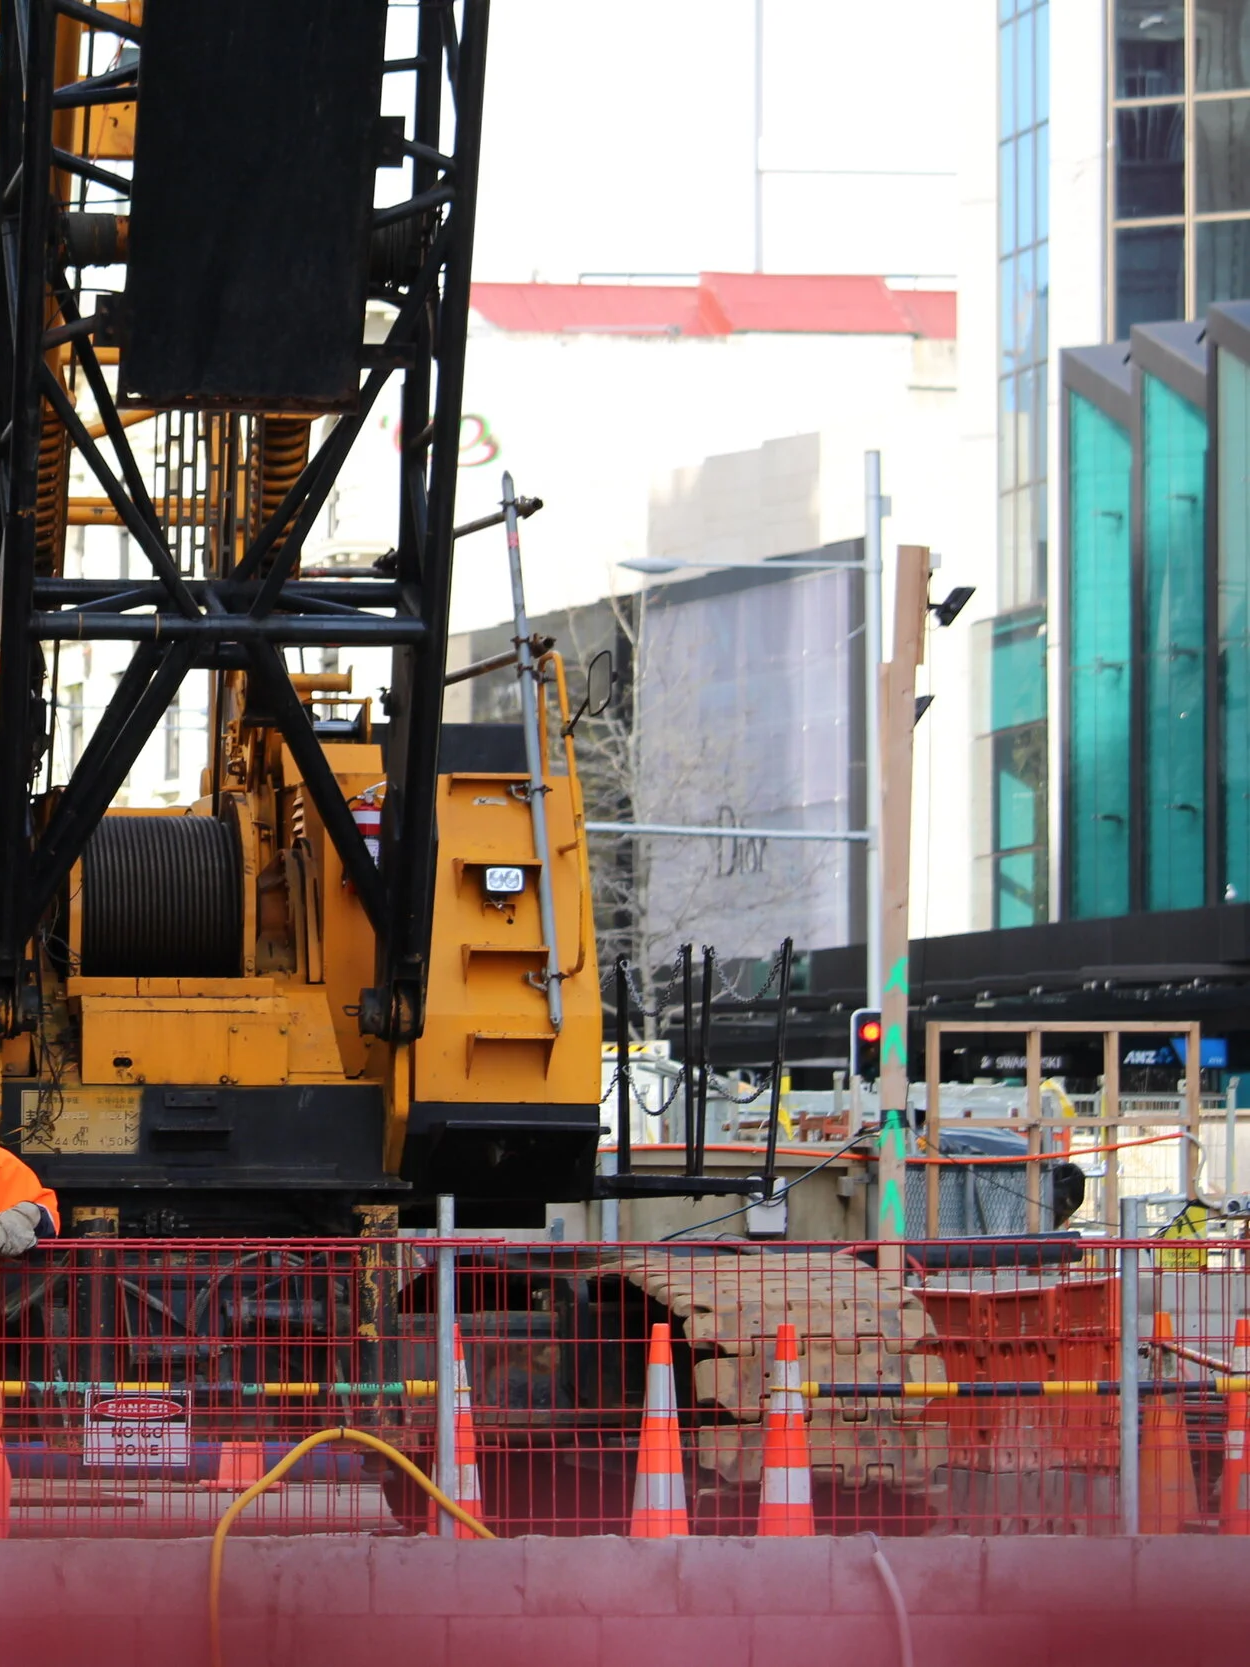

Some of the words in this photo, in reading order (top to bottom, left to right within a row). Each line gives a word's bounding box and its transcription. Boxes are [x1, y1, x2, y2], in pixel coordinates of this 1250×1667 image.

[1123, 1050, 1157, 1065] ANZ
[108, 1403, 168, 1413] DANGER
[111, 1427, 134, 1439] NO
